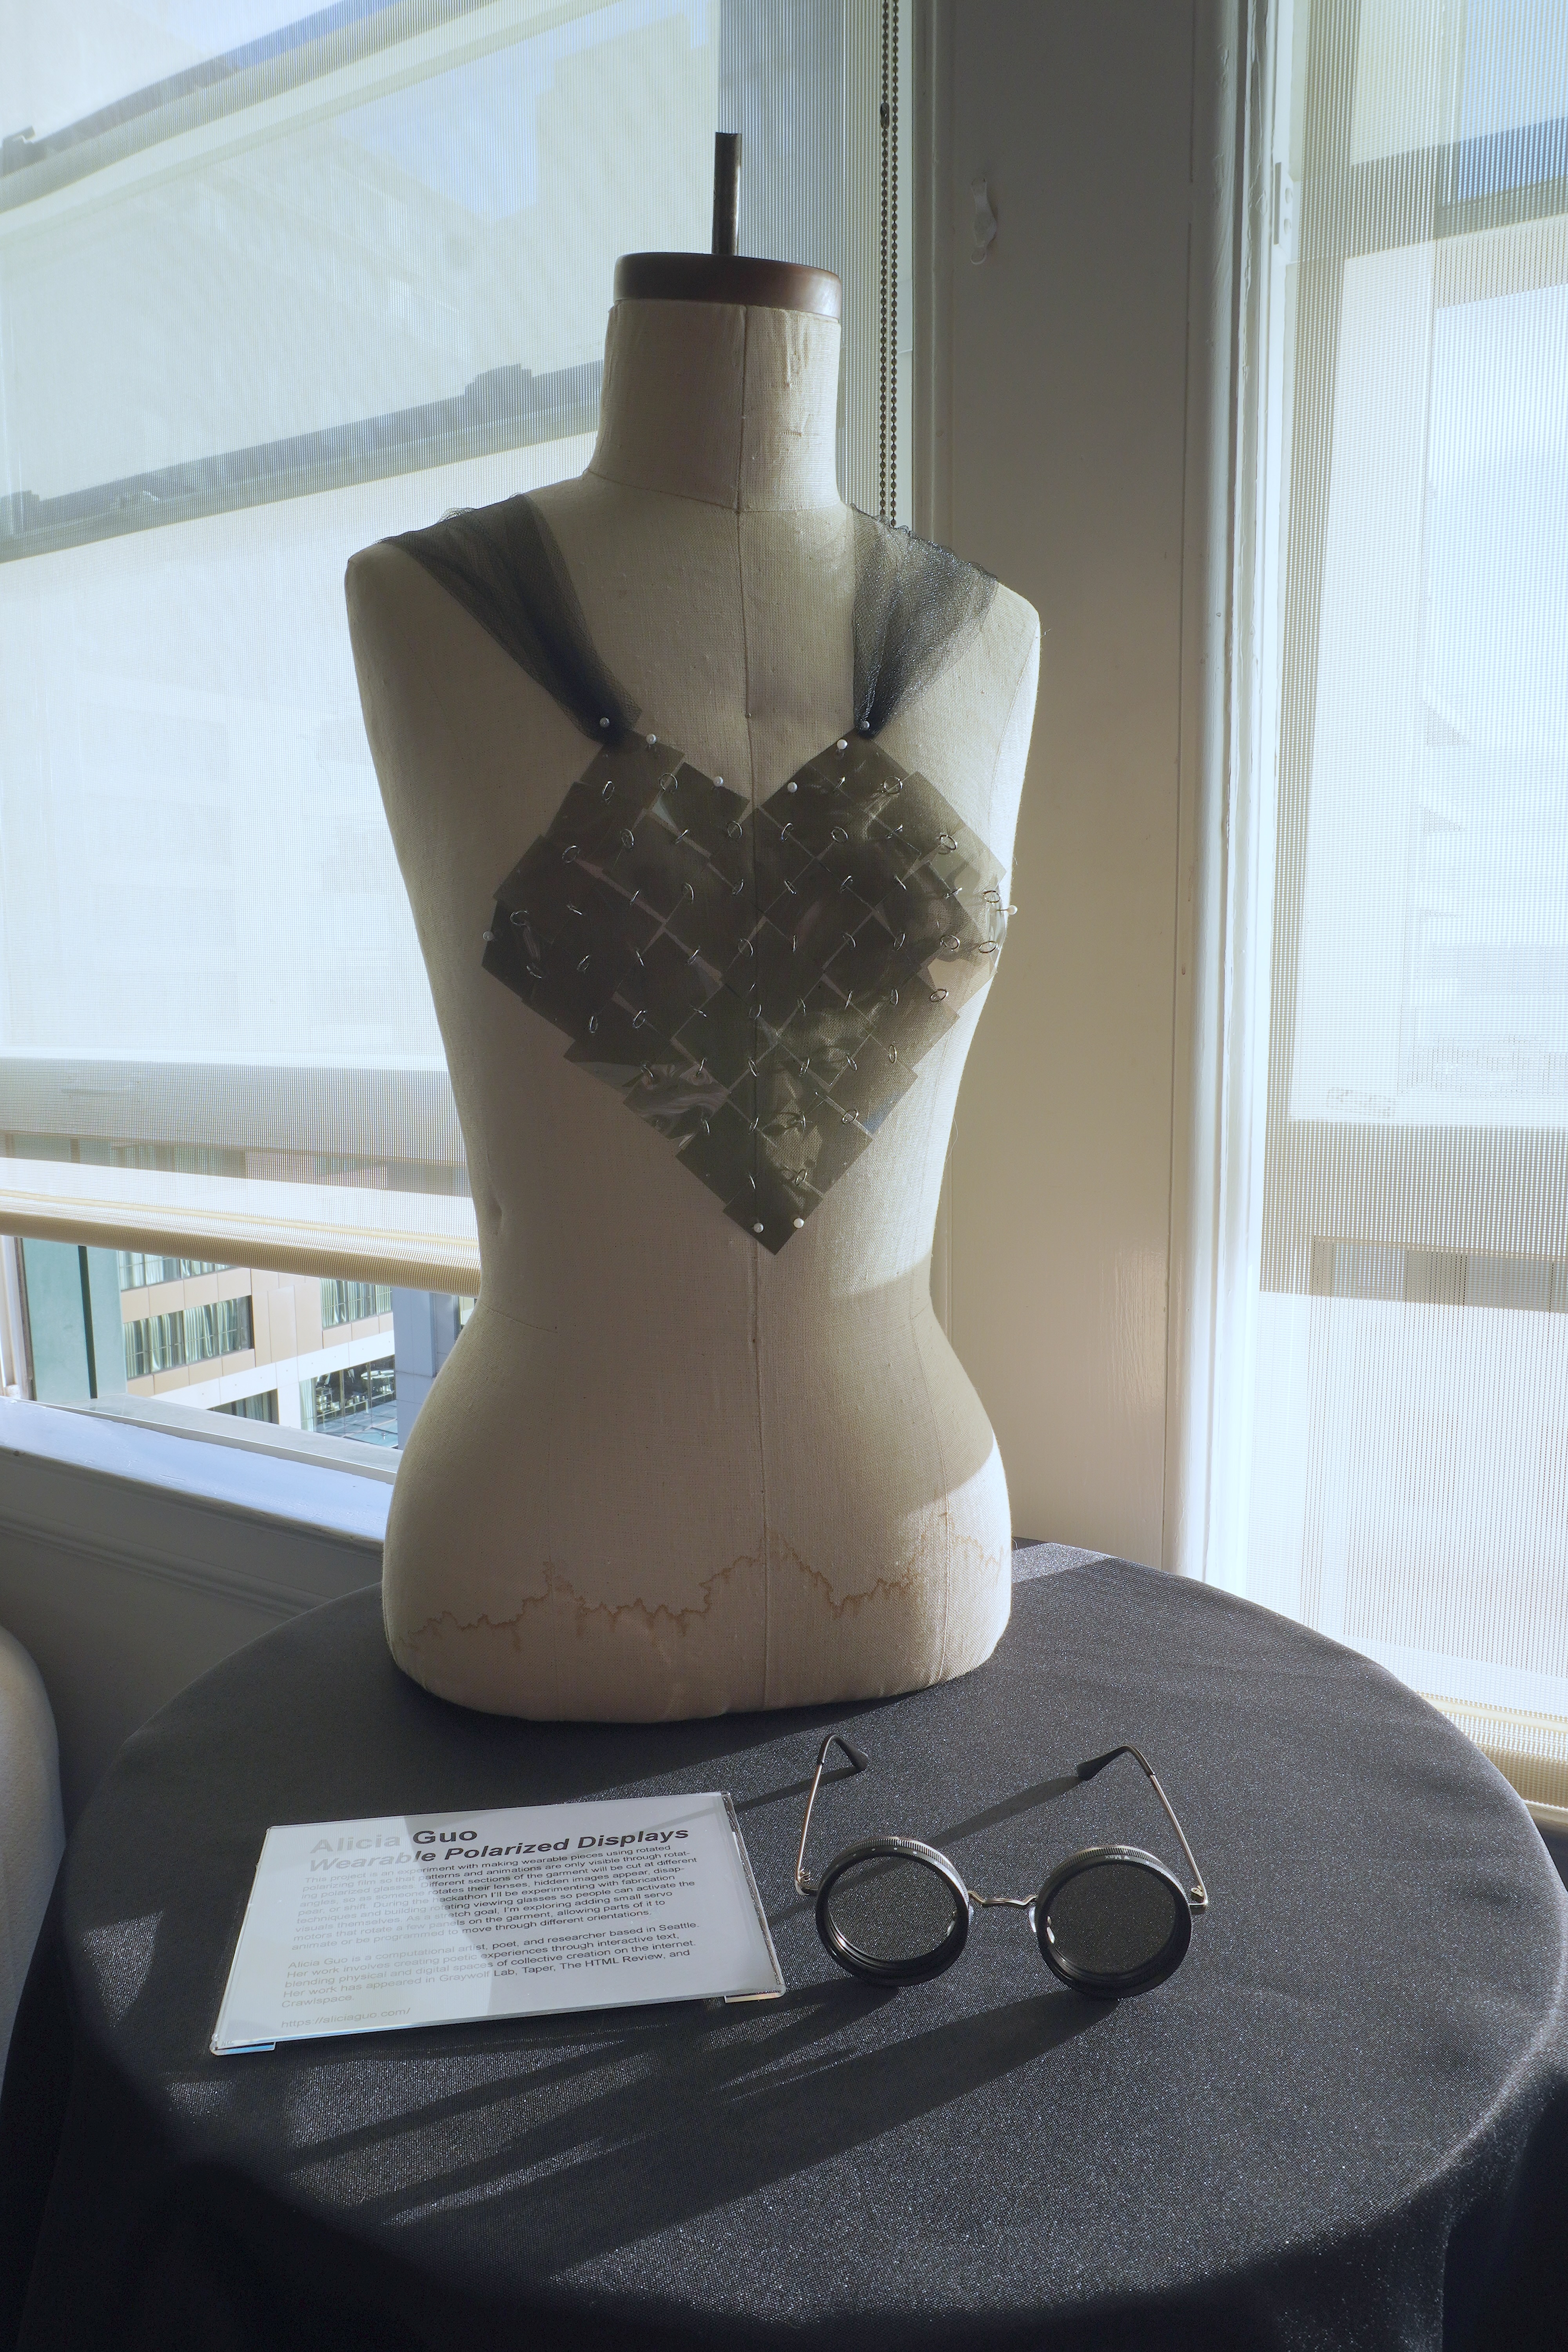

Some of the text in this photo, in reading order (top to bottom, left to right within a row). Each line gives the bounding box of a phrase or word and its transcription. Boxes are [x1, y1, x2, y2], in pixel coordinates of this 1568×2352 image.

[309, 1830, 477, 1854] Alicia Guo
[310, 1829, 688, 1871] Wearable Polarized Displays
[303, 1882, 354, 1892] polarizing
[418, 1873, 461, 1882] patterns
[486, 1866, 542, 1875] animations
[622, 1853, 661, 1862] through
[321, 1887, 370, 1898] polarized
[420, 1879, 465, 1888] Different
[468, 1876, 511, 1884] sections
[546, 1868, 588, 1878] garment
[656, 1857, 697, 1866] different
[330, 1873, 366, 1882] project
[397, 1865, 455, 1875] experiment
[521, 1855, 568, 1864] wearable
[570, 1853, 603, 1861] pieces
[636, 1844, 670, 1853] rotated
[297, 1913, 357, 1923] techniques
[385, 1907, 426, 1915] building
[430, 1903, 470, 1911] rotating
[472, 1899, 513, 1907] viewing
[516, 1895, 557, 1905] glasses
[575, 1889, 611, 1899] people
[636, 1883, 676, 1891] activate
[298, 1908, 325, 1917] pear,
[432, 1893, 487, 1903] hackathon
[521, 1883, 595, 1895] experimenting
[621, 1875, 675, 1885] fabrication
[375, 1891, 424, 1900] someone
[612, 1870, 650, 1879] appear,
[292, 1940, 337, 1950] animate
[373, 1929, 444, 1944] programmed
[495, 1921, 536, 1931] through
[540, 1916, 584, 1926] different
[586, 1910, 652, 1921] orientations.
[293, 1933, 332, 1941] motors
[429, 1919, 465, 1929] panels
[505, 1911, 553, 1922] garment,
[557, 1907, 600, 1916] allowing
[603, 1904, 630, 1913] parts
[295, 1923, 334, 1932] visuals
[337, 1918, 403, 1928] themselves.
[434, 1910, 470, 1919] stretch
[474, 1907, 500, 1917] goal,
[523, 1902, 571, 1911] exploring
[574, 1898, 610, 1906] adding
[613, 1893, 641, 1902] small
[285, 1977, 335, 1987] blending
[339, 1971, 386, 1984] physical
[390, 1968, 412, 1977] and
[416, 1964, 449, 1975] digital
[452, 1962, 493, 1972] spaces
[510, 1955, 563, 1965] collective
[566, 1950, 610, 1959] creation
[652, 1940, 696, 1950] internet.
[288, 1960, 320, 1968] Alicia
[375, 1945, 454, 1960] computational
[458, 1944, 488, 1952] artist,
[492, 1940, 519, 1950] poet,
[523, 1937, 544, 1945] and
[548, 1932, 606, 1943] researcher
[610, 1927, 642, 1936] based
[659, 1922, 699, 1931] Seattle.
[311, 1966, 340, 1975] work
[343, 1962, 390, 1972] involves
[394, 1958, 439, 1967] creating
[443, 1953, 477, 1964] poetic
[480, 1947, 548, 1959] experiences
[551, 1942, 593, 1952] through
[597, 1936, 653, 1947] interactive
[308, 1985, 337, 1994] work
[366, 1976, 421, 1990] appeared
[439, 1970, 490, 1982] Graywolf
[494, 1968, 518, 1976] Lab,
[521, 1965, 556, 1974] Taper,
[585, 1957, 619, 1967] HTML
[622, 1953, 665, 1962] Review,
[669, 1949, 690, 1957] and
[281, 1995, 355, 2007] Crawlspace.
[281, 2007, 410, 2028] https://aliciaguo.com/
